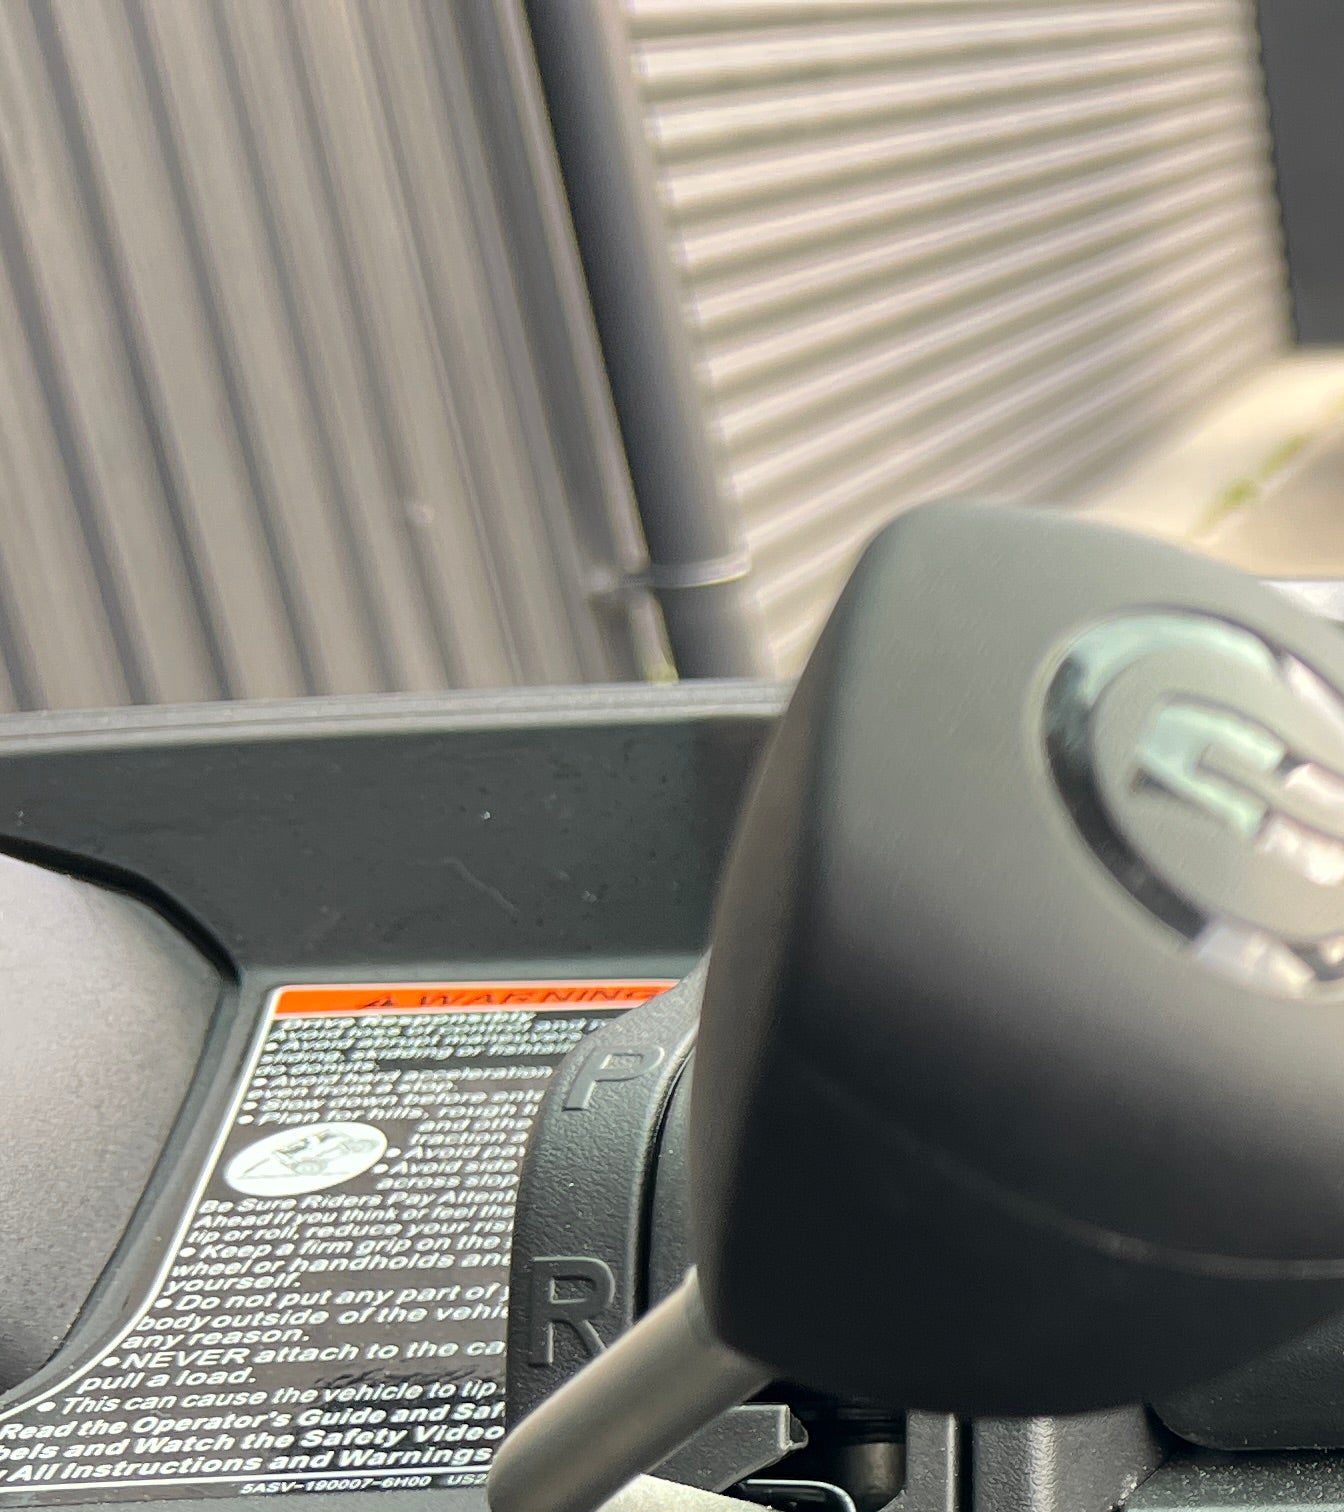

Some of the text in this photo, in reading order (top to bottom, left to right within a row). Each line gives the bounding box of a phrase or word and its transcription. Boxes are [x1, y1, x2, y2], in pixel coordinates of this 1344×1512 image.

[269, 1027, 346, 1041] Avoid
[281, 1039, 356, 1050] Avoid
[270, 1074, 341, 1088] Avoid
[343, 1070, 402, 1086] hard
[561, 1046, 665, 1111] P
[248, 1088, 310, 1100] even
[313, 1084, 373, 1098] from
[327, 1095, 399, 1109] down
[402, 1092, 488, 1106] before
[257, 1111, 321, 1126] Plan
[437, 1104, 518, 1118] rough
[417, 1118, 472, 1132] and
[410, 1132, 507, 1145] traction
[403, 1145, 482, 1159] Avoid
[388, 1160, 464, 1174] Avoid
[375, 1176, 463, 1190] across
[199, 1200, 236, 1214] Be
[236, 1199, 297, 1213] Sure
[301, 1194, 384, 1210] Riders
[384, 1191, 438, 1207] Pay
[194, 1213, 271, 1228] Ahead
[294, 1211, 338, 1227] you
[340, 1207, 400, 1222] think
[401, 1208, 429, 1220] or
[427, 1205, 479, 1219] feel
[186, 1228, 222, 1244] tip
[223, 1230, 251, 1242] or
[252, 1225, 301, 1241] roll,
[304, 1221, 403, 1238] reduce
[403, 1221, 470, 1237] your
[200, 1243, 273, 1259] Keep
[273, 1244, 295, 1255] a
[295, 1239, 354, 1255] firm
[354, 1236, 413, 1255] grip
[414, 1237, 451, 1250] on
[454, 1234, 502, 1249] the
[171, 1260, 252, 1277] wheel
[252, 1261, 286, 1275] or
[290, 1253, 455, 1272] handholds
[162, 1273, 302, 1296] yourself.
[174, 1294, 222, 1311] Do
[223, 1292, 278, 1309] not
[277, 1290, 333, 1310] put
[334, 1287, 395, 1305] any
[397, 1282, 463, 1303] part
[463, 1281, 499, 1300] of
[136, 1313, 211, 1331] body
[210, 1308, 331, 1329] outside
[336, 1305, 376, 1324] of
[374, 1304, 429, 1322] the
[528, 1256, 617, 1368] R
[120, 1329, 311, 1350] any reason.
[121, 1349, 251, 1369] NEVER
[253, 1344, 361, 1363] attach
[364, 1344, 401, 1359] to
[405, 1341, 460, 1358] the
[75, 1367, 258, 1394] pull a load.
[61, 1396, 121, 1415] This
[123, 1397, 181, 1411] can
[180, 1391, 269, 1409] cause
[270, 1387, 321, 1405] the
[323, 1383, 426, 1402] vehicle
[426, 1382, 459, 1398] to
[459, 1378, 500, 1400] tip
[0, 1421, 79, 1441] Read
[77, 1419, 129, 1436] the
[132, 1411, 293, 1435] Operator's
[296, 1406, 388, 1427] Guide
[389, 1404, 451, 1422] and
[62, 1438, 131, 1457] and
[133, 1433, 237, 1454] Watch
[239, 1431, 296, 1450] the
[299, 1424, 410, 1448] Safety
[412, 1424, 506, 1443] Video
[6, 1462, 62, 1482] All
[60, 1454, 263, 1479] Instructions
[267, 1450, 335, 1471] and
[336, 1445, 494, 1467] Warnings
